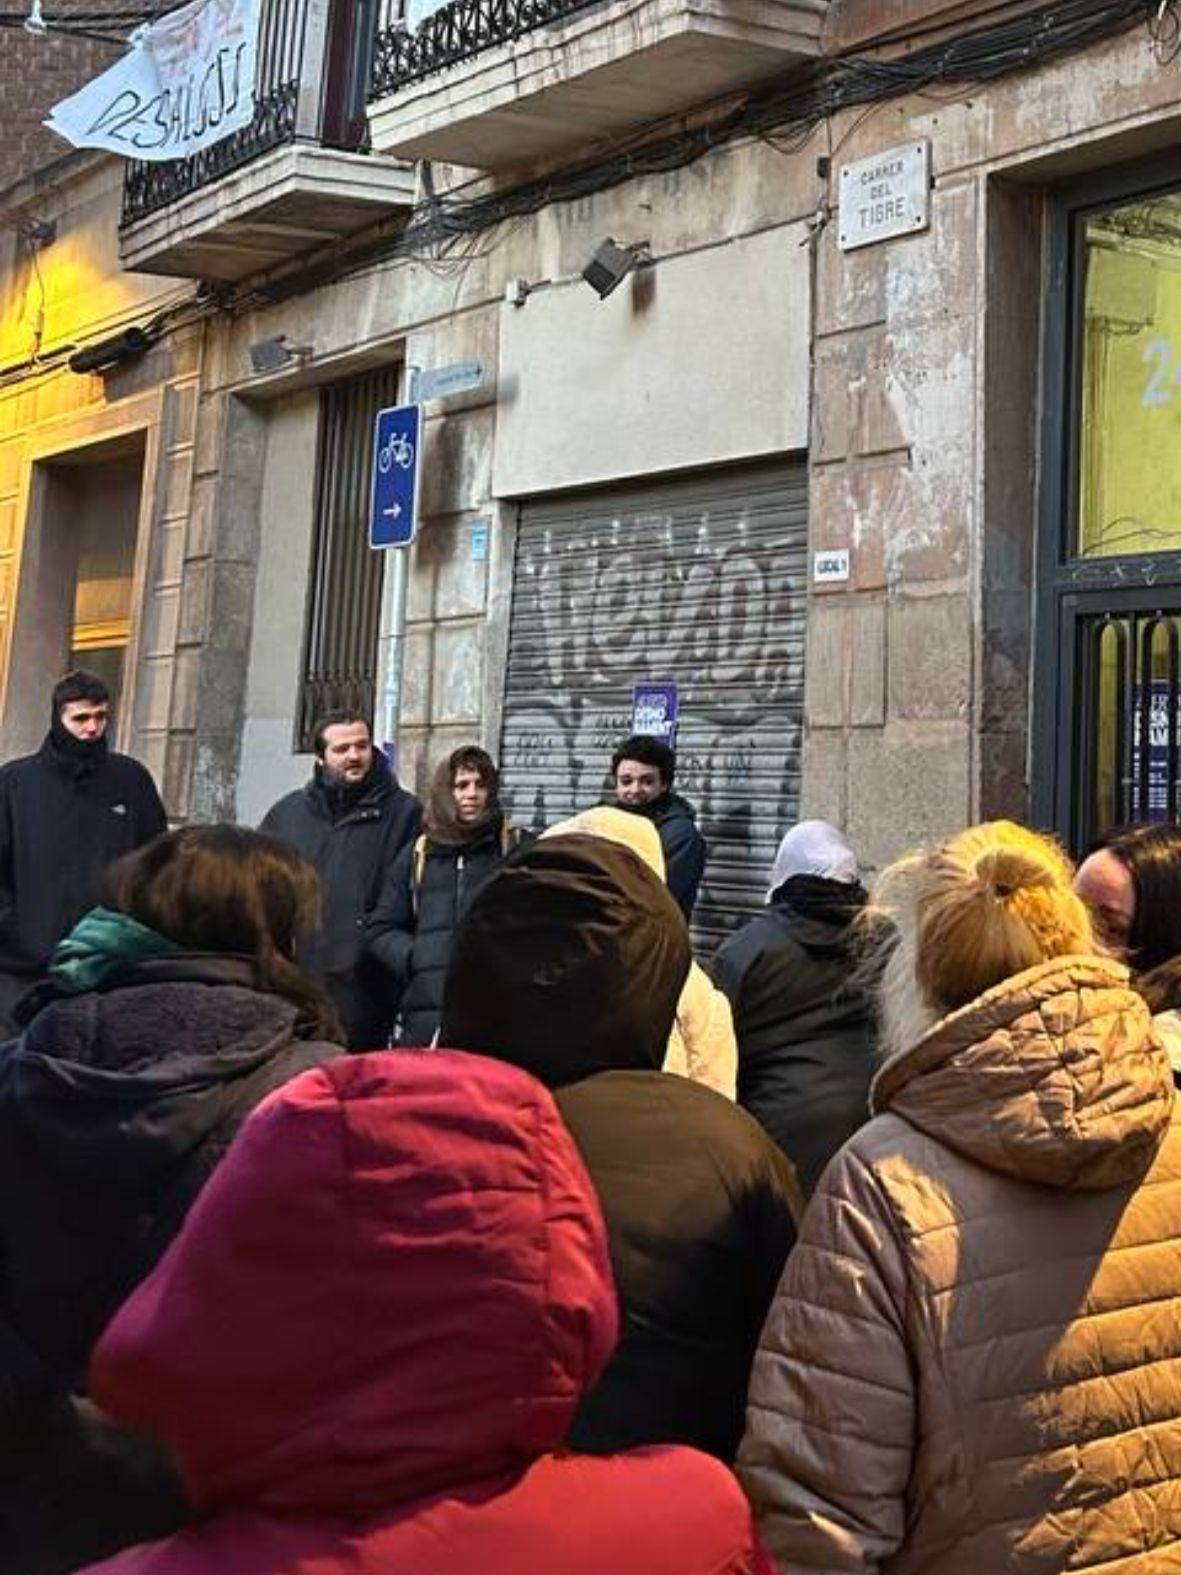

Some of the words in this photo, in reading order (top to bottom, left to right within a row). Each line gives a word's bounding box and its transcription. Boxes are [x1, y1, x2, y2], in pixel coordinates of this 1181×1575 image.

[860, 160, 904, 185] CARRER
[870, 183, 892, 200] DEL
[859, 197, 905, 228] TIGRE
